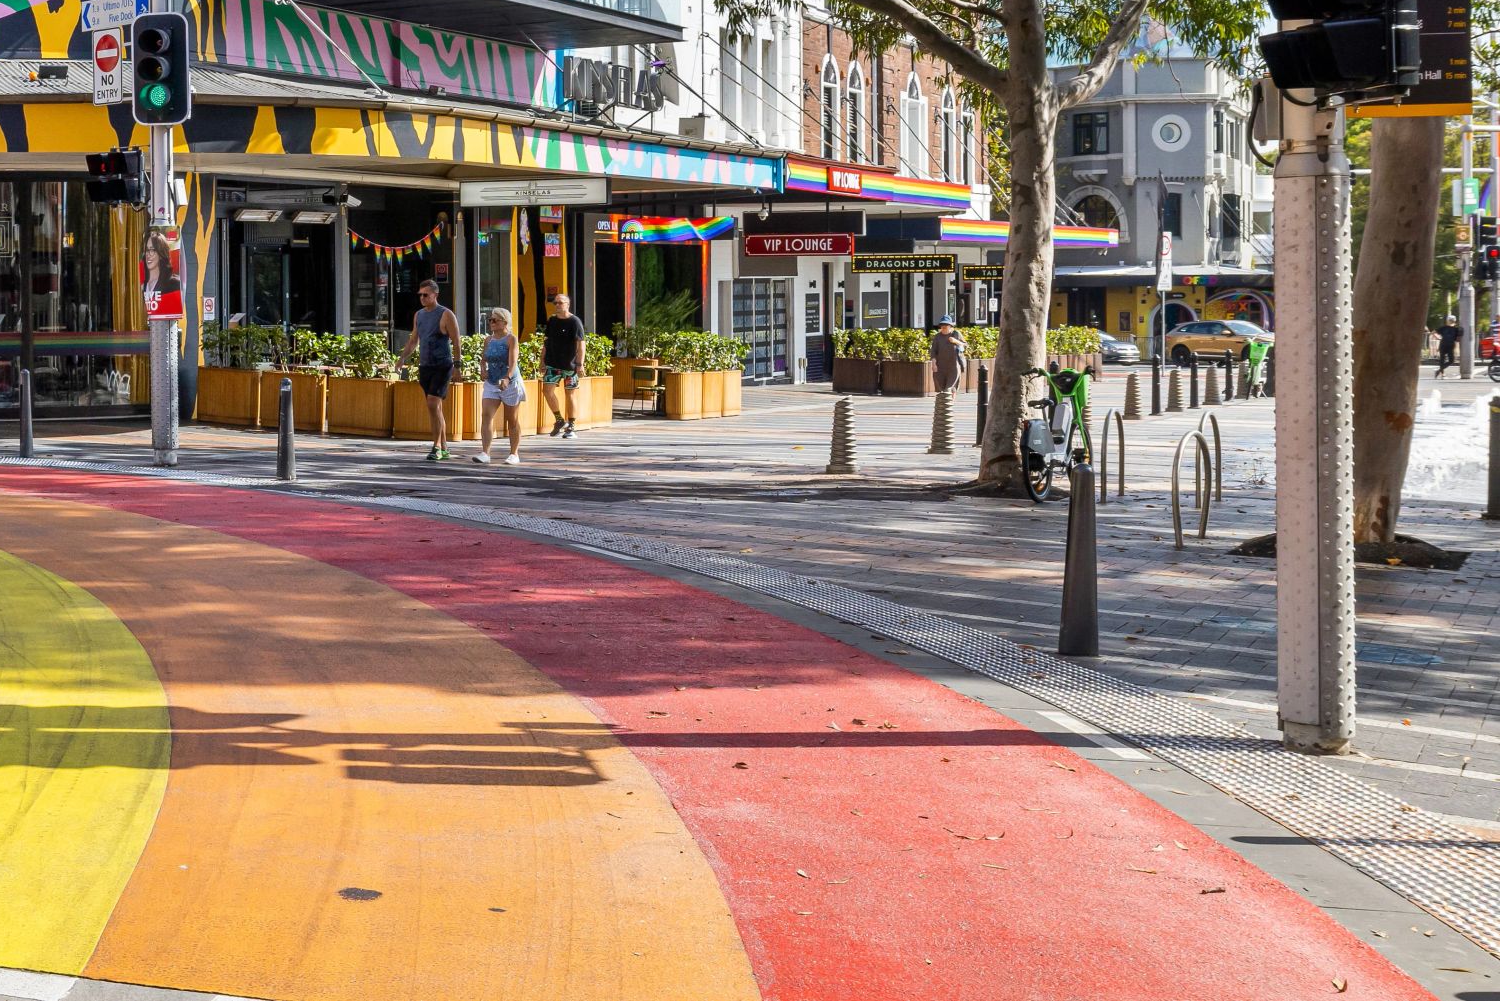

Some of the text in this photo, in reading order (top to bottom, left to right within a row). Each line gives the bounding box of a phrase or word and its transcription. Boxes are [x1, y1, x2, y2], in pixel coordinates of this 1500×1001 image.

[103, 1, 121, 11] Ultimo
[108, 13, 120, 23] Five
[120, 10, 134, 21] Dock
[1424, 69, 1442, 80] Hall
[101, 74, 114, 87] NO
[564, 55, 665, 112] KINSELAS
[97, 88, 118, 100] ENTRY
[597, 220, 611, 230] OPEN
[621, 232, 644, 240] PRIDE
[764, 238, 833, 251] VIP LOUNGE
[866, 259, 940, 268] DRAGONS DEN
